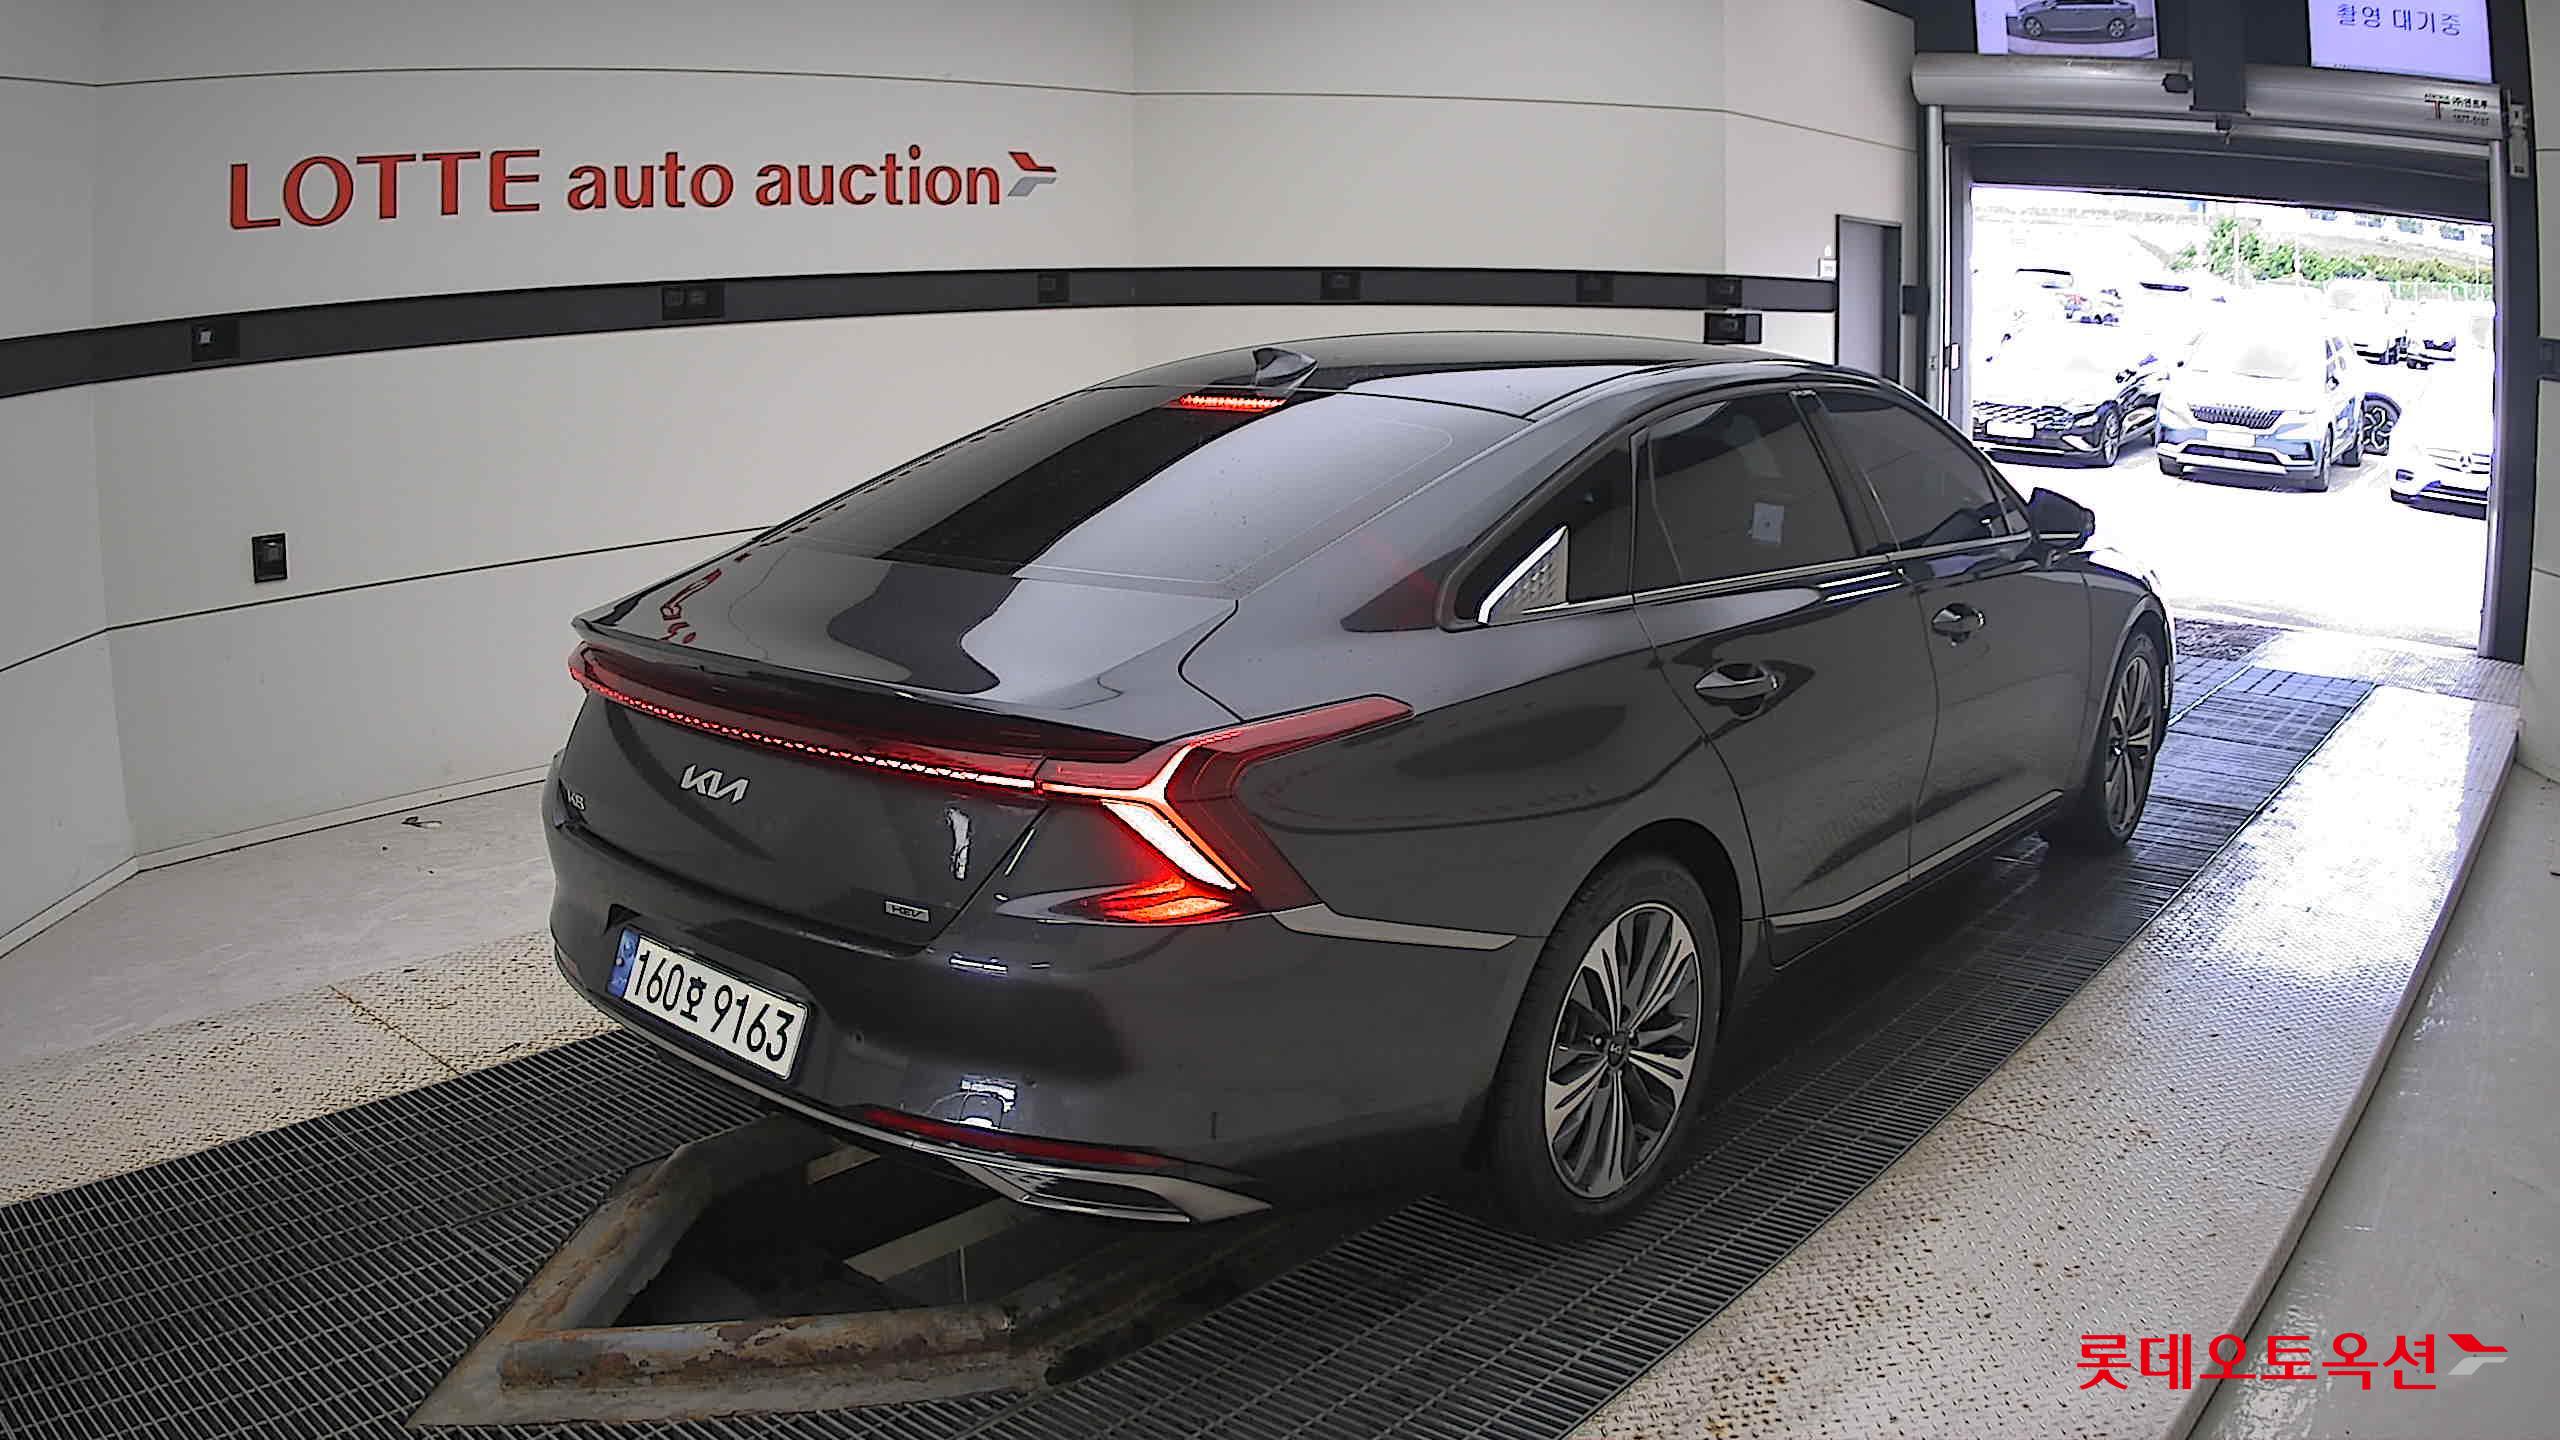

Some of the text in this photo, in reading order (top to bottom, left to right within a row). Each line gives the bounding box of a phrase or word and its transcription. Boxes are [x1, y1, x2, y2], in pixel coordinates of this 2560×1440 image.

[2337, 3, 2462, 37] 촬영 대기중
[229, 144, 1003, 231] LOTTE auto auction
[566, 788, 586, 810] K8
[680, 764, 749, 804] KIA
[634, 950, 795, 1062] 160호 9163
